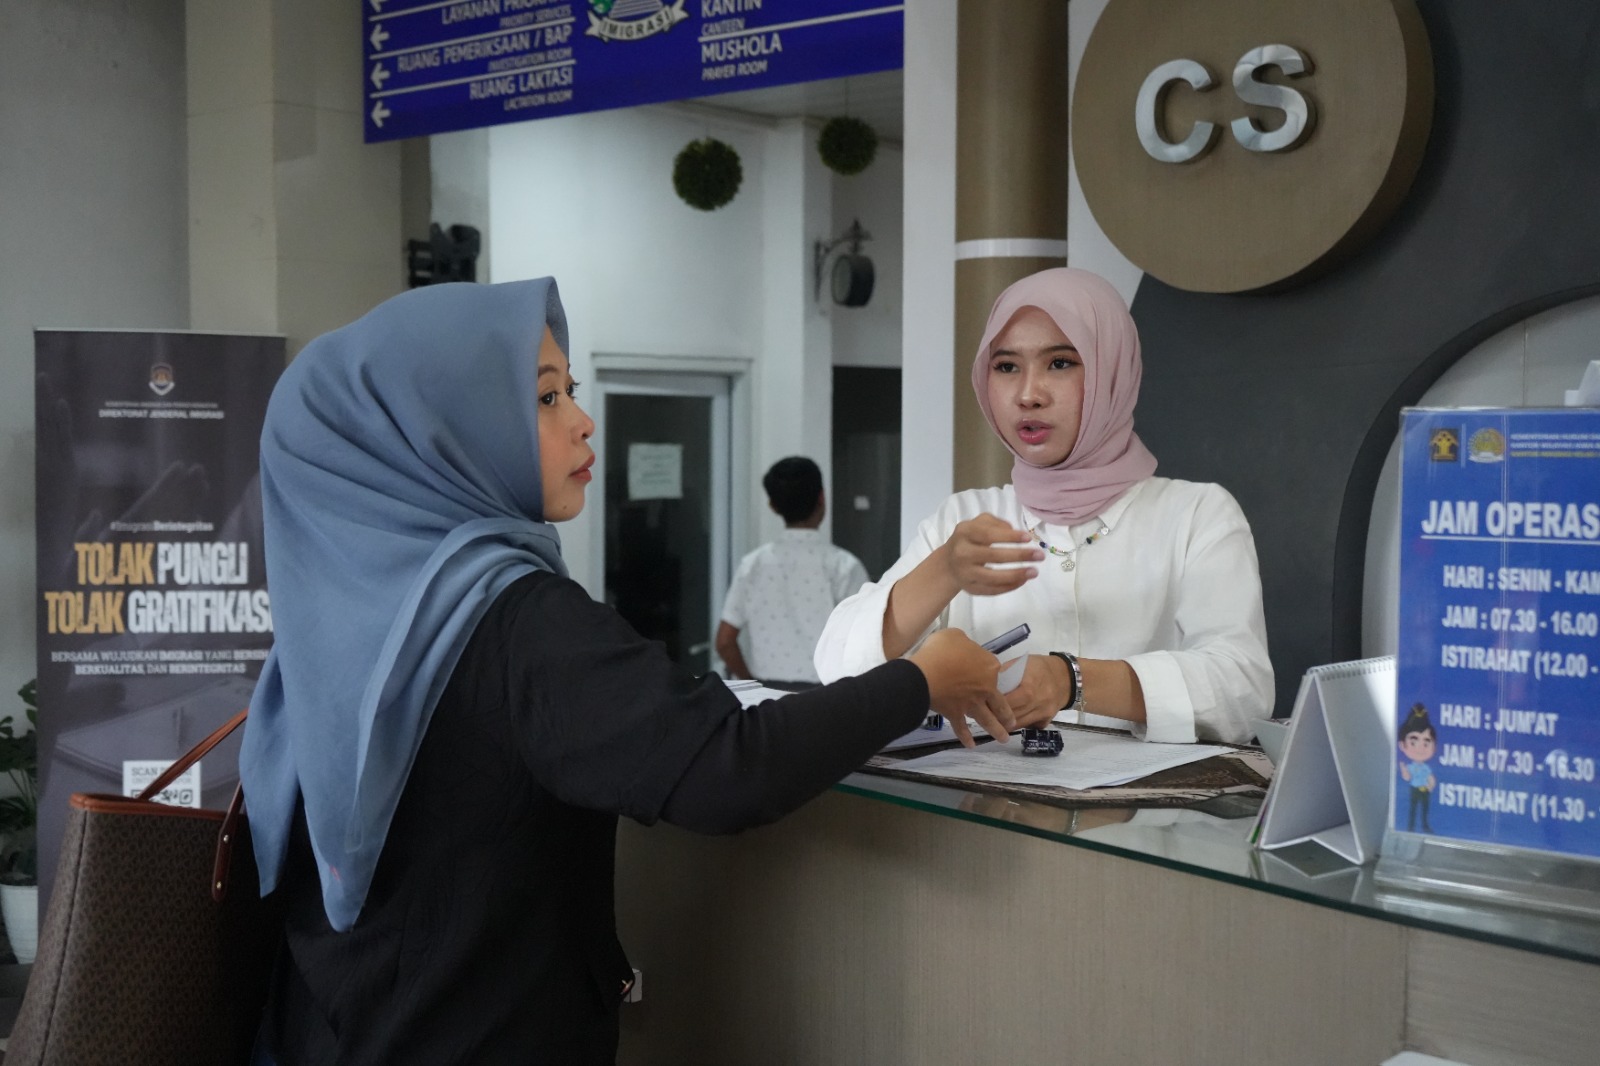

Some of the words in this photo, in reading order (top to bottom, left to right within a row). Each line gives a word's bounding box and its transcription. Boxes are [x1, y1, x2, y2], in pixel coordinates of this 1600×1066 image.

[602, 10, 670, 38] IMIGRASI
[397, 49, 440, 73] RUANG
[443, 32, 530, 65] PEMERIKSAAN
[534, 31, 541, 48] /
[544, 25, 572, 46] BAP
[701, 32, 783, 63] MUSHOLA
[469, 76, 516, 100] RUANG
[519, 66, 573, 91] LAKTASI
[737, 59, 768, 76] ROOM
[1135, 43, 1309, 164] CS
[1421, 500, 1479, 535] JAM
[1486, 501, 1600, 539] OPERAS
[74, 542, 155, 585] TOLAK
[156, 541, 249, 585] PUNGLI
[1443, 565, 1484, 589] HARI
[1497, 566, 1552, 592] SENIN
[44, 590, 125, 634] TOLAK
[1441, 605, 1478, 629] JAM
[1490, 607, 1537, 633] 07.30
[1550, 610, 1599, 637] 16.00
[51, 651, 99, 662] BERSAMA
[146, 664, 167, 674] DAN
[1441, 644, 1532, 673] ISTIRAHAT
[1534, 651, 1588, 681] (12.00
[1439, 703, 1481, 729] HARI
[1493, 708, 1559, 736] JUM'AT
[131, 766, 158, 776] SCAN
[1439, 743, 1475, 768] JAM
[1487, 748, 1534, 776] 07.30
[1547, 752, 1595, 782] 16.30
[1439, 782, 1529, 815] ISTIRAHAT
[1531, 793, 1585, 823] (11.30
